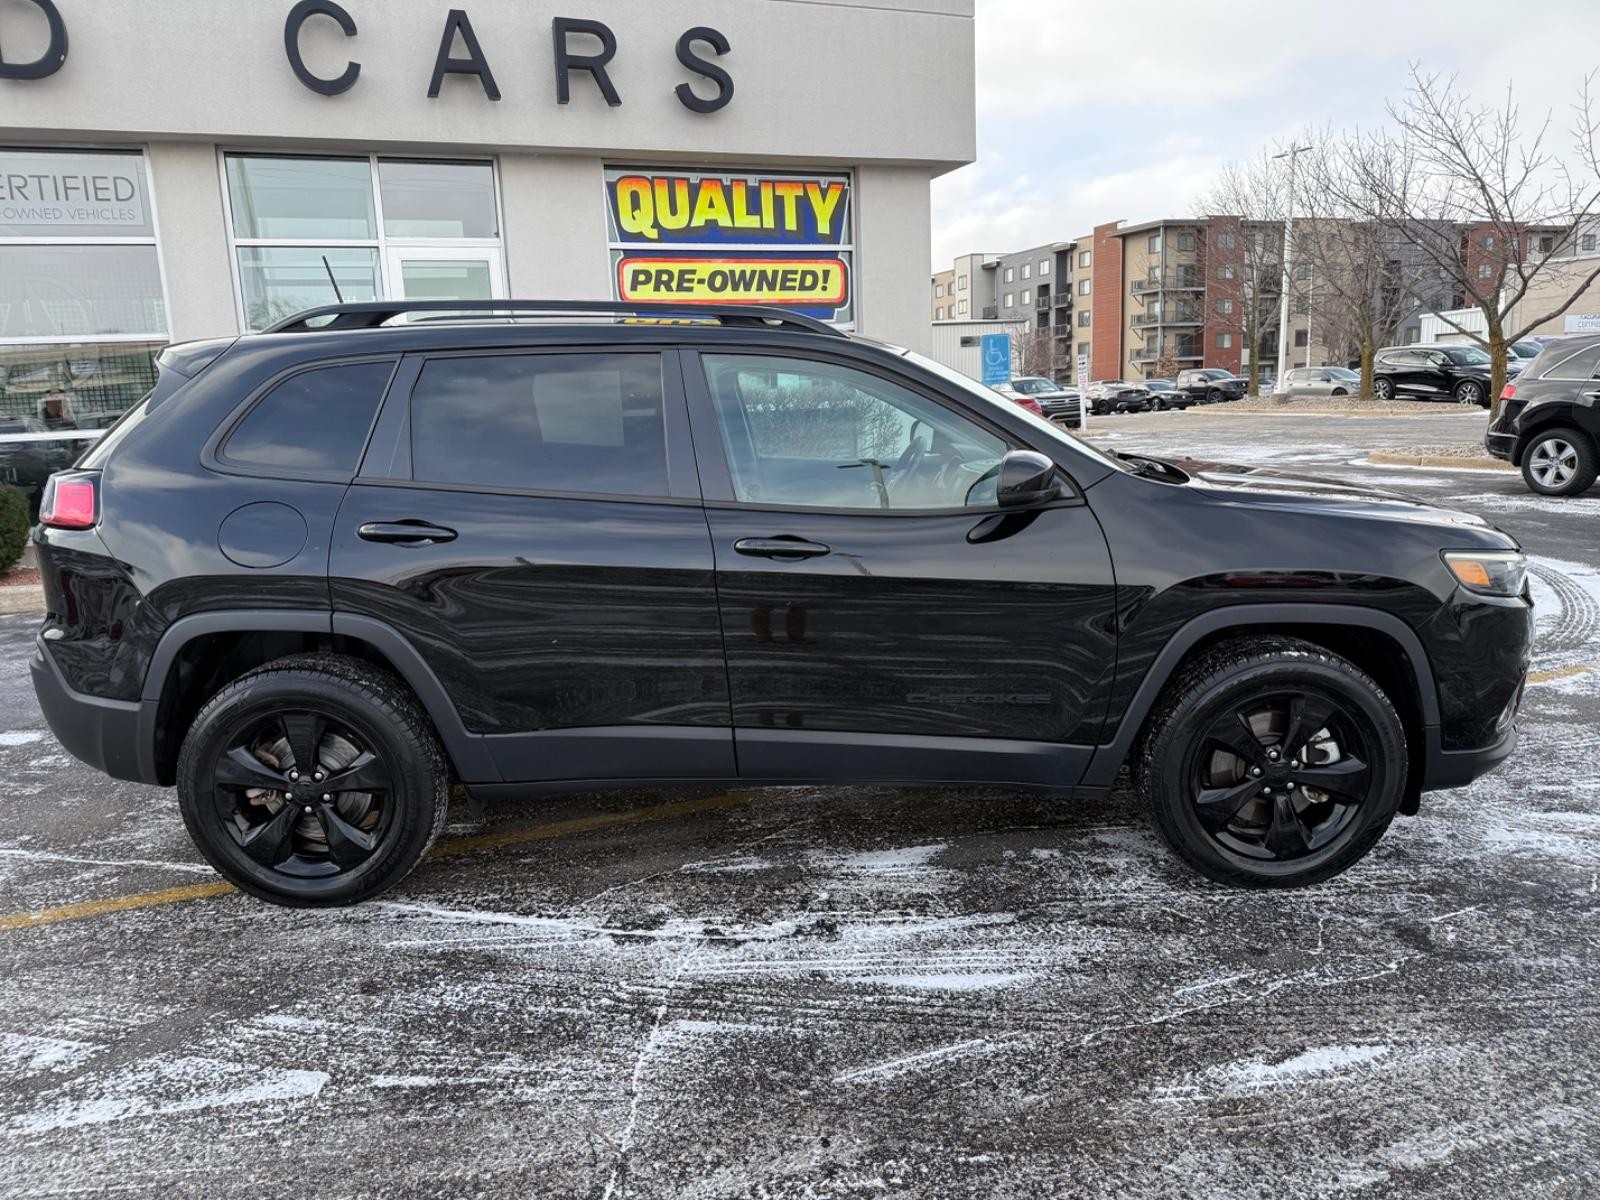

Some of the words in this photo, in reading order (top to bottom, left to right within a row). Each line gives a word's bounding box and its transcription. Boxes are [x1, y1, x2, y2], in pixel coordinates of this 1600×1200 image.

[284, 0, 734, 114] CARS
[67, 207, 136, 221] VEHICLES
[616, 176, 845, 240] QUALITY
[629, 268, 831, 293] PRE-OWNED!
[906, 692, 1052, 705] CHEROKEE
